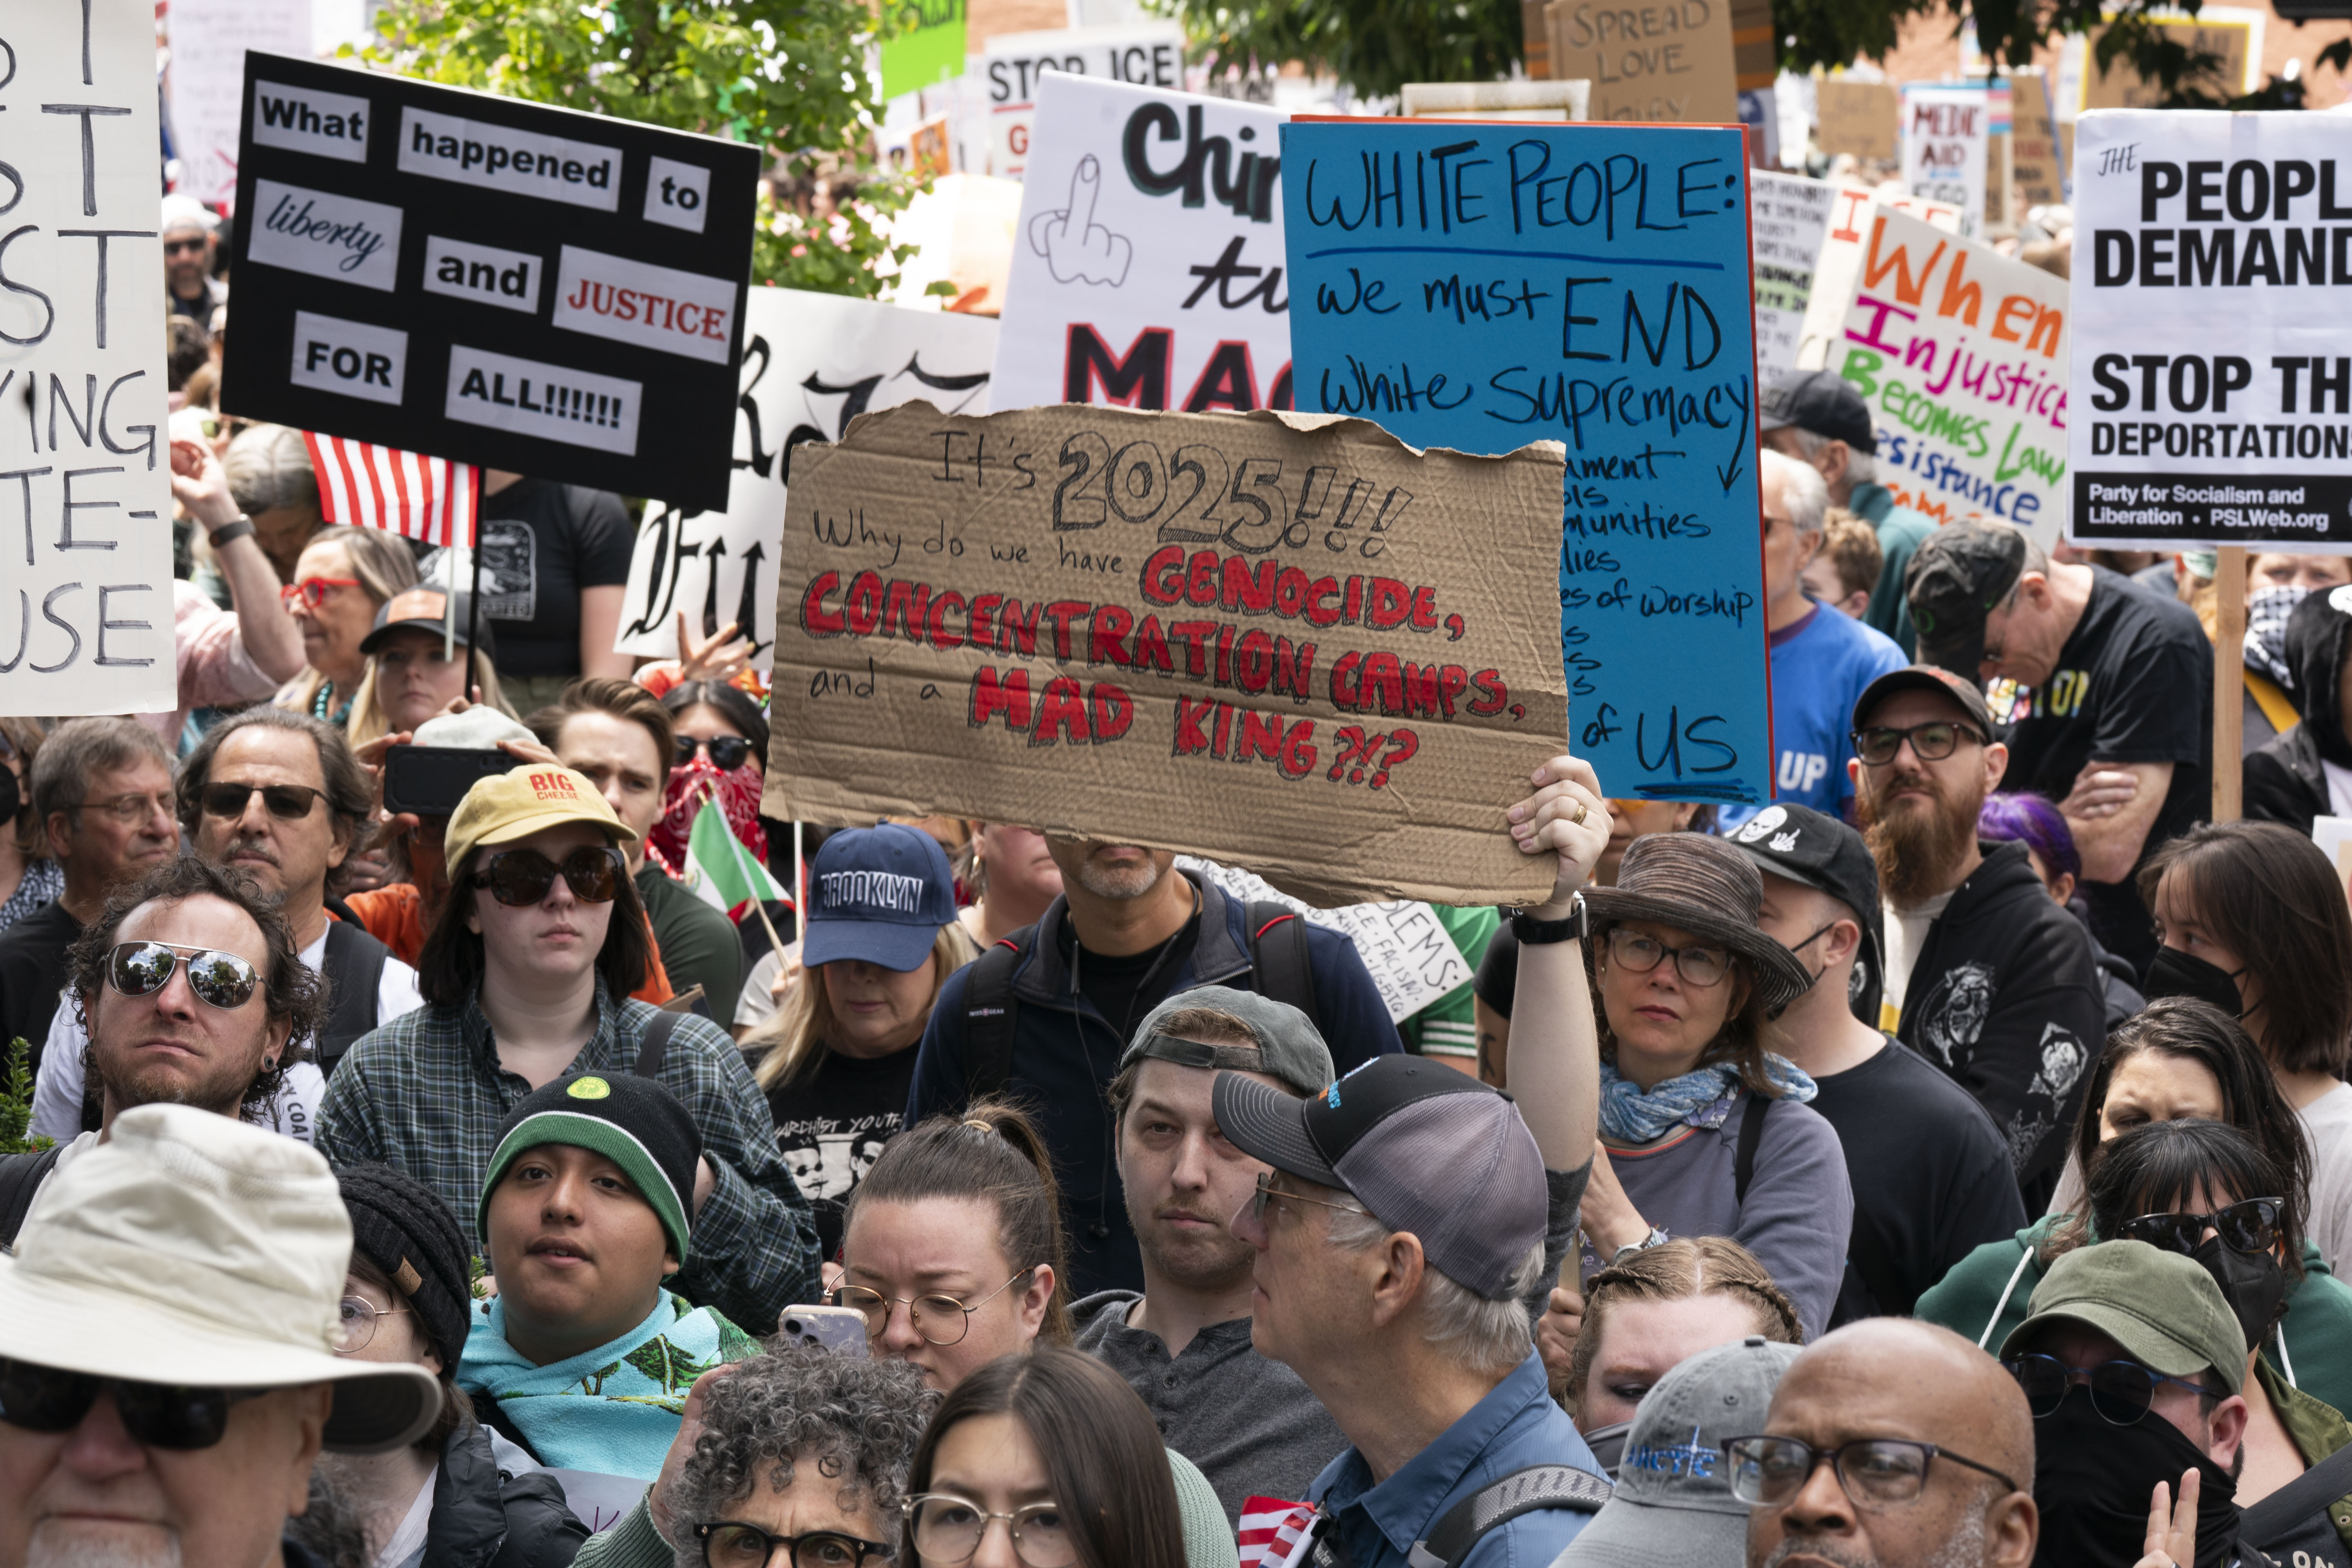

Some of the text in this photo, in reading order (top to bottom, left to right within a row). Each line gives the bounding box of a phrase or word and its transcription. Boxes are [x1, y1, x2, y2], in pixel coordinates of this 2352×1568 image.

[1569, 0, 1711, 49] SPREAD
[1111, 45, 1172, 85] ICE
[1597, 43, 1693, 83] LOVE
[261, 96, 363, 141] What
[413, 122, 611, 189] happened
[660, 176, 700, 211] to
[2098, 142, 2141, 176] THE
[1305, 140, 1494, 235] WHITE
[1508, 140, 1737, 241] PEOPLE:
[265, 194, 726, 342] liberty and JUSTICE
[1864, 216, 2063, 359] When
[1317, 268, 1401, 315] We
[1562, 277, 1722, 372] END
[305, 340, 622, 429] FOR ALL!!!!!!
[1485, 366, 1750, 452] Supremacy
[1840, 348, 1990, 458] Becomes
[2091, 353, 2252, 413] STOP
[1994, 422, 2065, 488] Law
[2091, 421, 2352, 459] DEPORTATION
[930, 430, 1414, 559] It's 2025!!!
[1875, 428, 2041, 526] esistance
[2089, 483, 2305, 506] Party for Socialism and
[2089, 506, 2330, 532] Liberation PSLWeb.org
[813, 508, 1466, 642] Why do we have GENOCIDE,
[1597, 577, 1633, 610] of
[800, 570, 1527, 722] CONCENTRATION CAMPS,
[809, 655, 875, 699] and
[920, 683, 942, 701] a
[967, 664, 1134, 749] MAD
[1581, 702, 1738, 780] of US
[1777, 750, 1827, 792] UP
[530, 773, 575, 791] BIG
[537, 791, 580, 801] CHEESE
[820, 871, 923, 914] BROOKLYN
